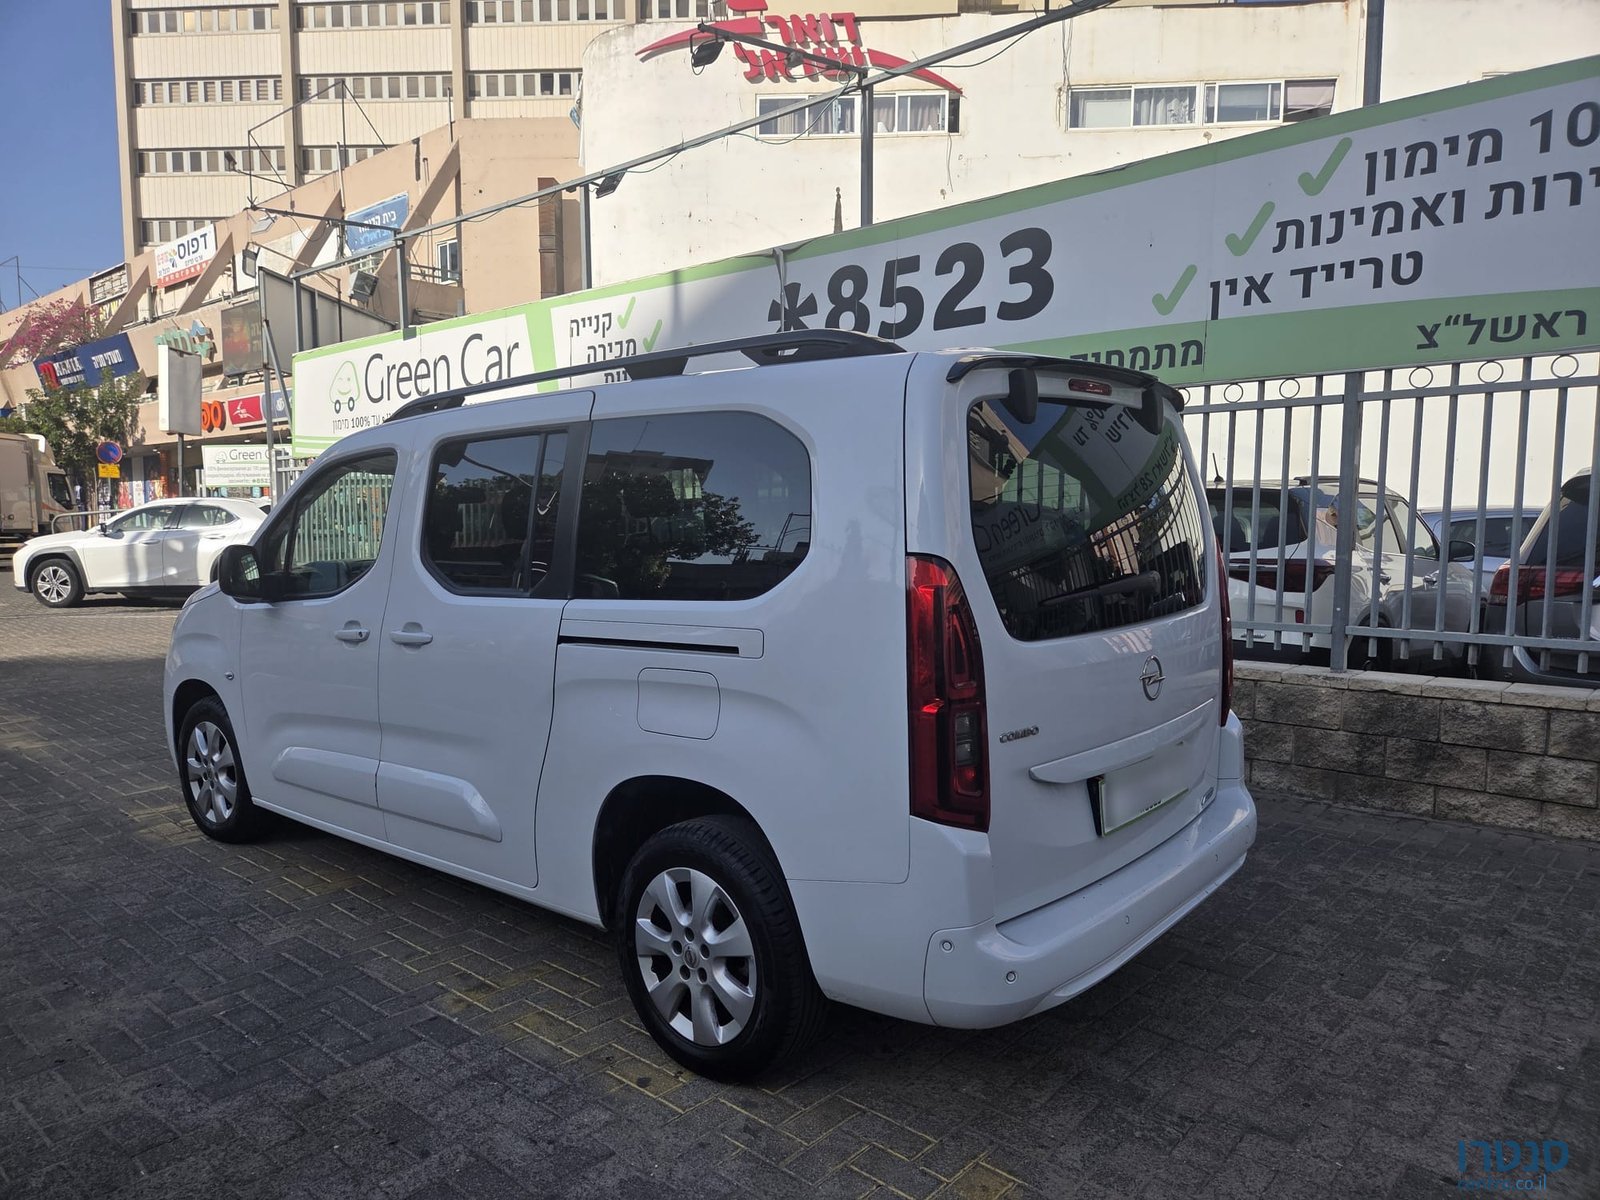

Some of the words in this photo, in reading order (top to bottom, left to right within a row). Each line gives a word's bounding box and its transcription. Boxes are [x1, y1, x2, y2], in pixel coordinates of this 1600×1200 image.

[764, 12, 856, 46] דואר
[1364, 127, 1504, 197] מימון
[1272, 188, 1466, 254] ואמינות
[177, 232, 208, 260] דפוס
[1289, 250, 1424, 299] טרייד
[1209, 272, 1274, 321] אין
[570, 311, 612, 339] קנייה
[587, 338, 637, 364] מכירה
[364, 352, 451, 404] Green
[460, 333, 520, 387] Car
[351, 416, 371, 429] 100%
[228, 448, 262, 461] Green
[999, 725, 1040, 744] COMBO
